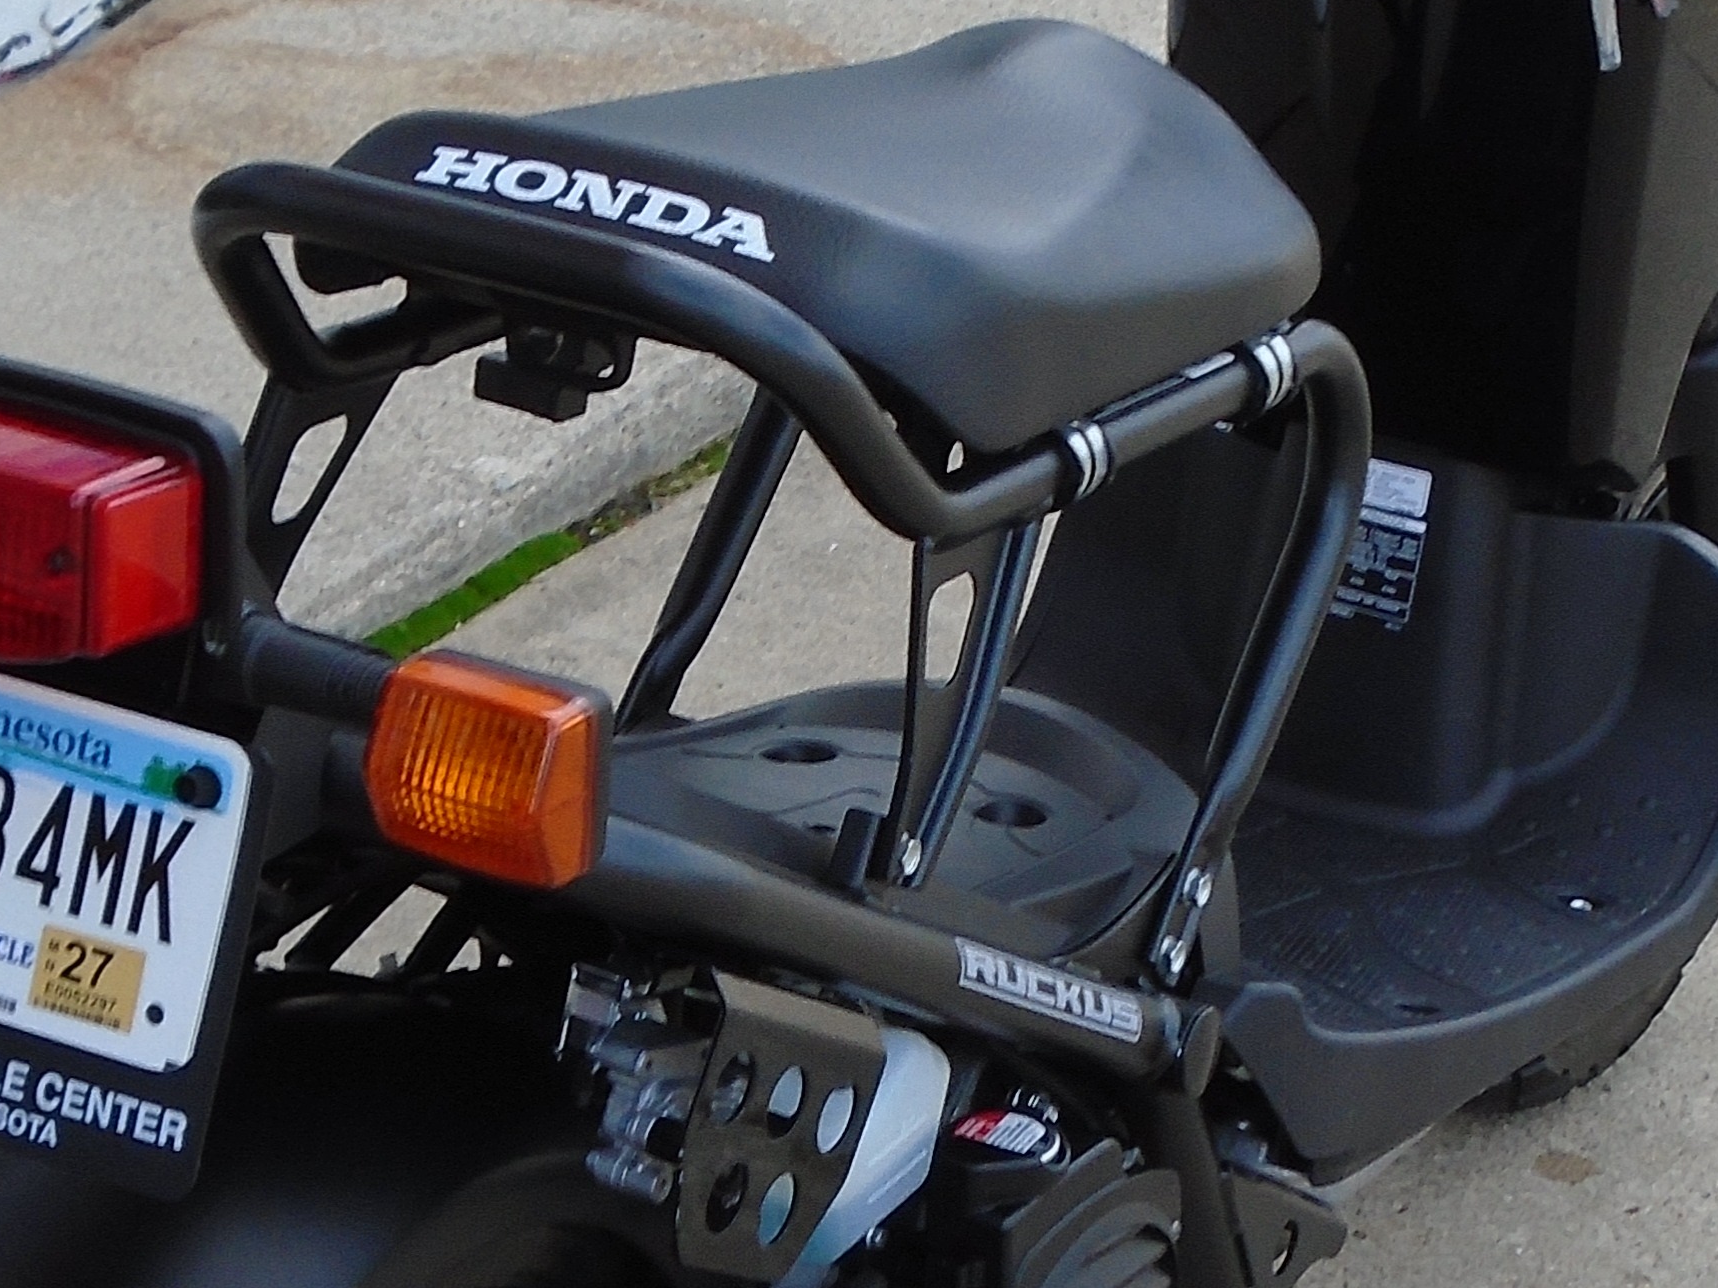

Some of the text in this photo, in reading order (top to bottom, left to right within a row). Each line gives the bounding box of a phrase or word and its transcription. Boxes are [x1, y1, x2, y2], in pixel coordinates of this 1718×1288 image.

[413, 145, 776, 263] HONDA
[59, 941, 115, 989] 27
[964, 946, 1139, 1031] RUCKUS
[35, 1071, 189, 1153] CENTER
